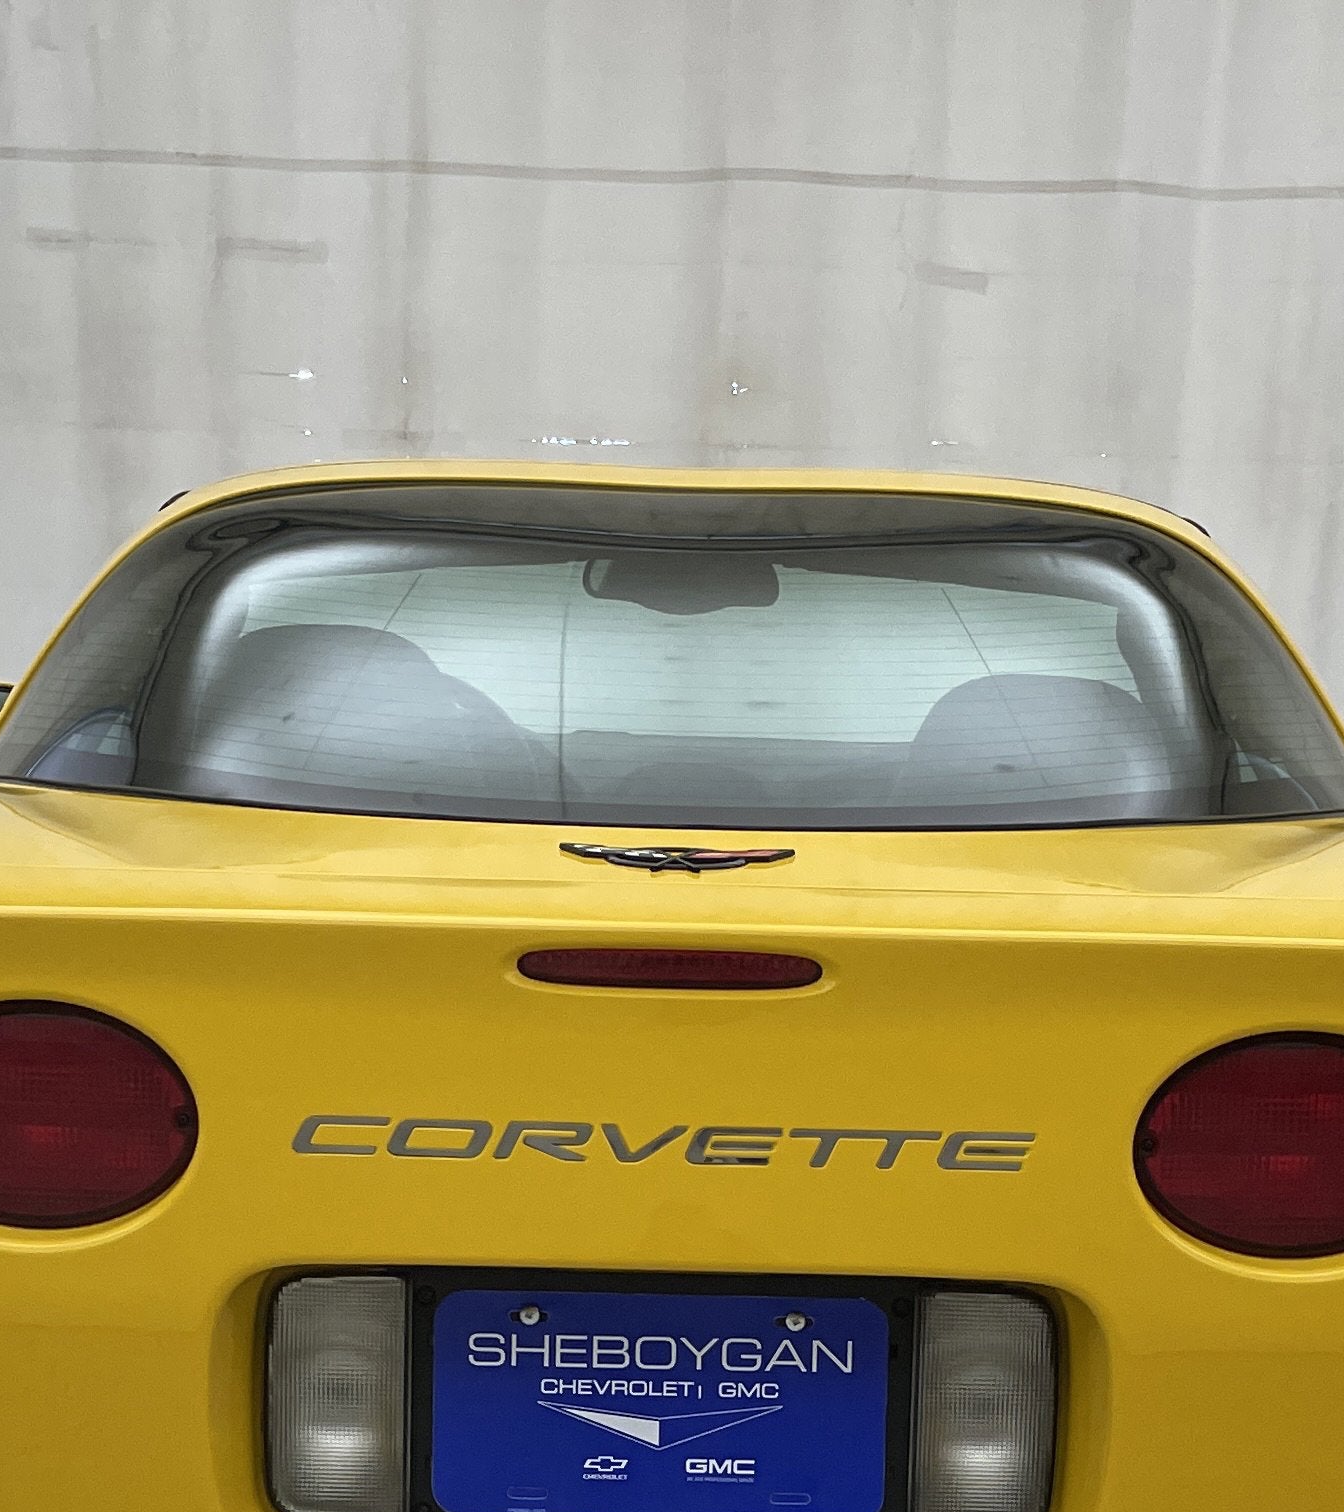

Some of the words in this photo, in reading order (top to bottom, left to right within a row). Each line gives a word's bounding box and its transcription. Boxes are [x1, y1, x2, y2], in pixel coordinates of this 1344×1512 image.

[291, 1115, 1036, 1171] CORVETTE
[468, 1332, 853, 1374] SHEBOYGAN
[540, 1378, 695, 1398] CHEVROLET
[718, 1382, 780, 1399] GMC
[685, 1458, 755, 1475] GMC
